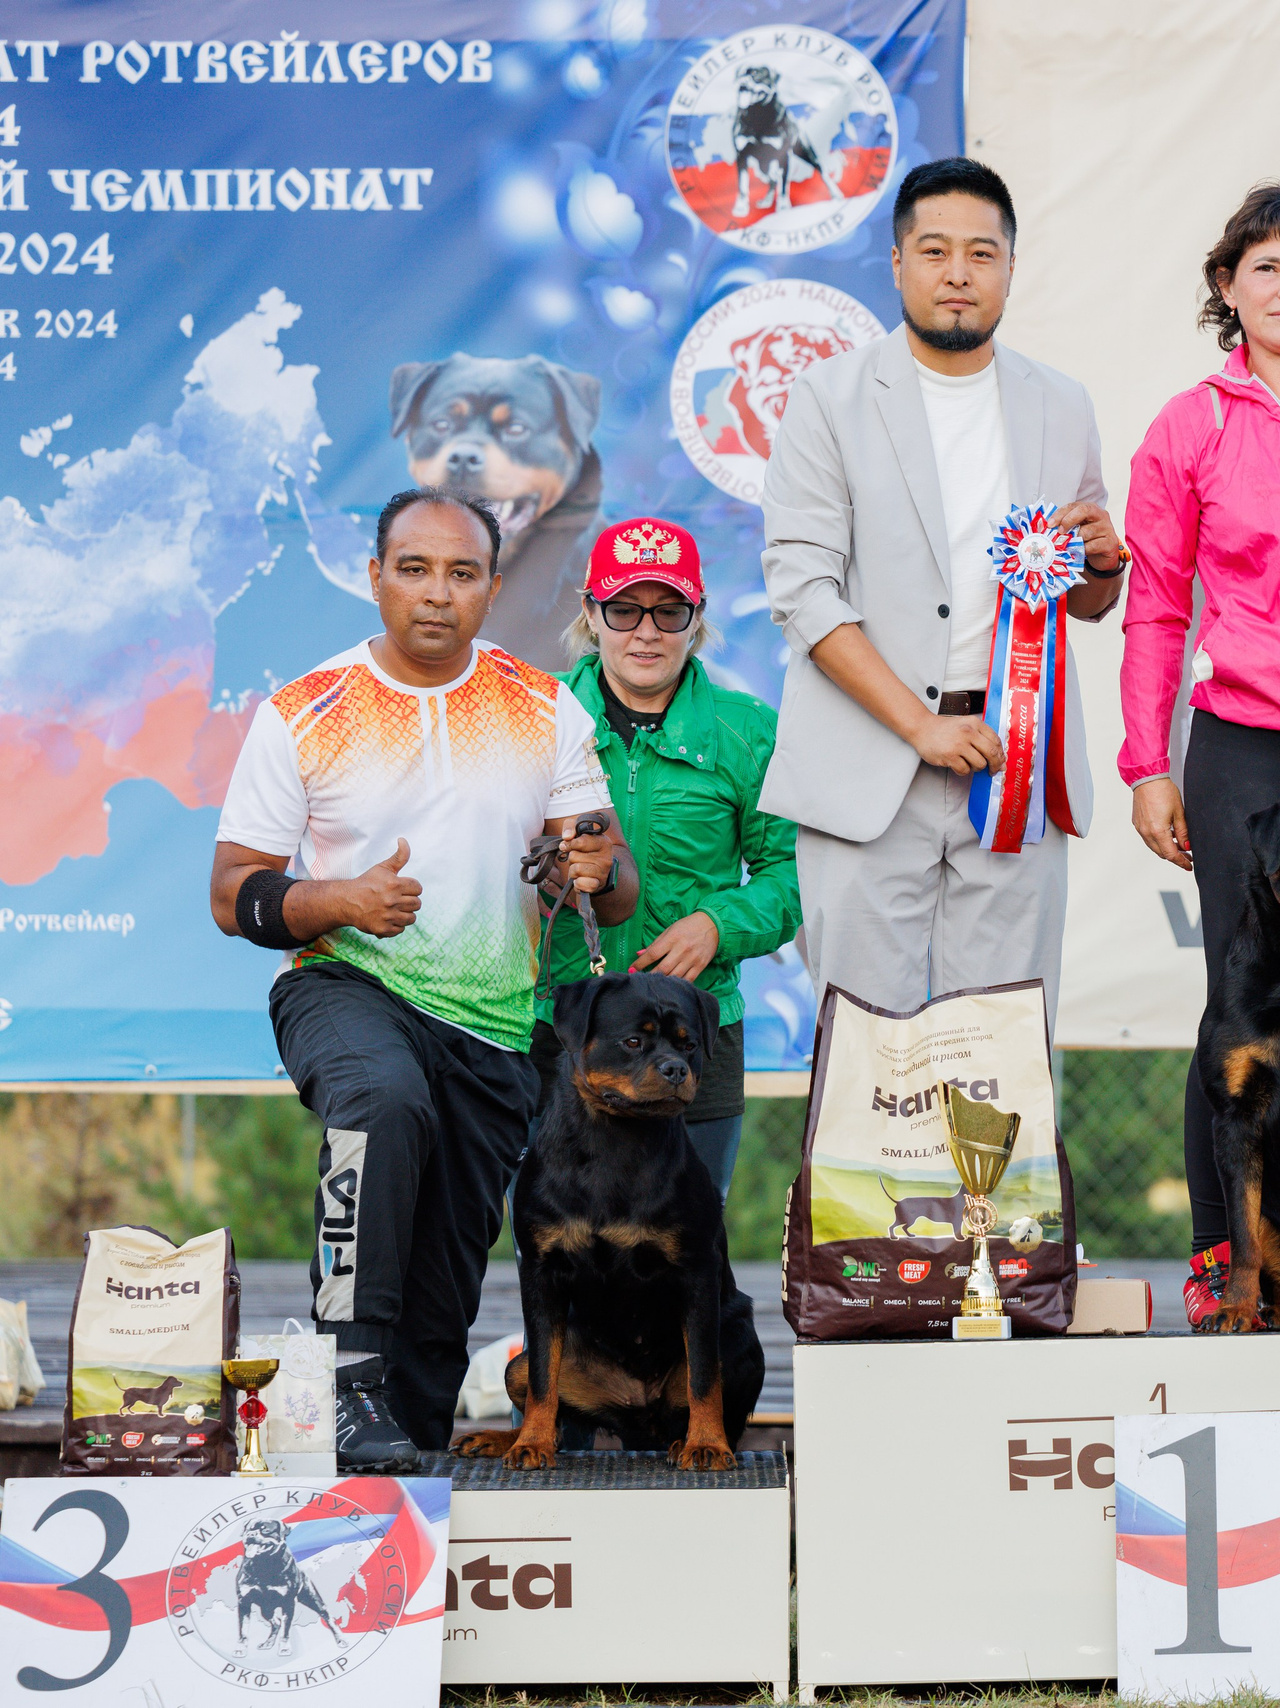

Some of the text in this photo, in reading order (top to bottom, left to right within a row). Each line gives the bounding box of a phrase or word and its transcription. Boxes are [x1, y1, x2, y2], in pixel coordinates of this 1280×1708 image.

[79, 31, 493, 84] РОТВЕЙЛЕРОВ
[773, 32, 849, 68] КЛУБ
[48, 167, 433, 212] ЧЕМПИОНАТ
[724, 212, 846, 247] РКФ-НКПР
[0, 232, 114, 275] 2024
[35, 309, 119, 339] 2024
[673, 302, 736, 381] РОССИИ
[740, 283, 787, 309] 2024
[1018, 704, 1028, 750] класса
[0, 907, 136, 939] Ротвейлер
[940, 1037, 970, 1047] средних
[971, 1033, 994, 1043] пород
[940, 1050, 972, 1063] рисом
[322, 1167, 358, 1277] FILA
[106, 1276, 200, 1301] Hanta
[904, 1271, 921, 1279] MEAT
[109, 1323, 190, 1336] SMALL/MEDIUM
[1147, 1425, 1252, 1655] 1
[171, 1490, 403, 1637] РОТВЕЙЛЕР КЛУБ РОССИИ
[17, 1489, 132, 1691] 3
[220, 1656, 349, 1688] РКФ-НКПР
